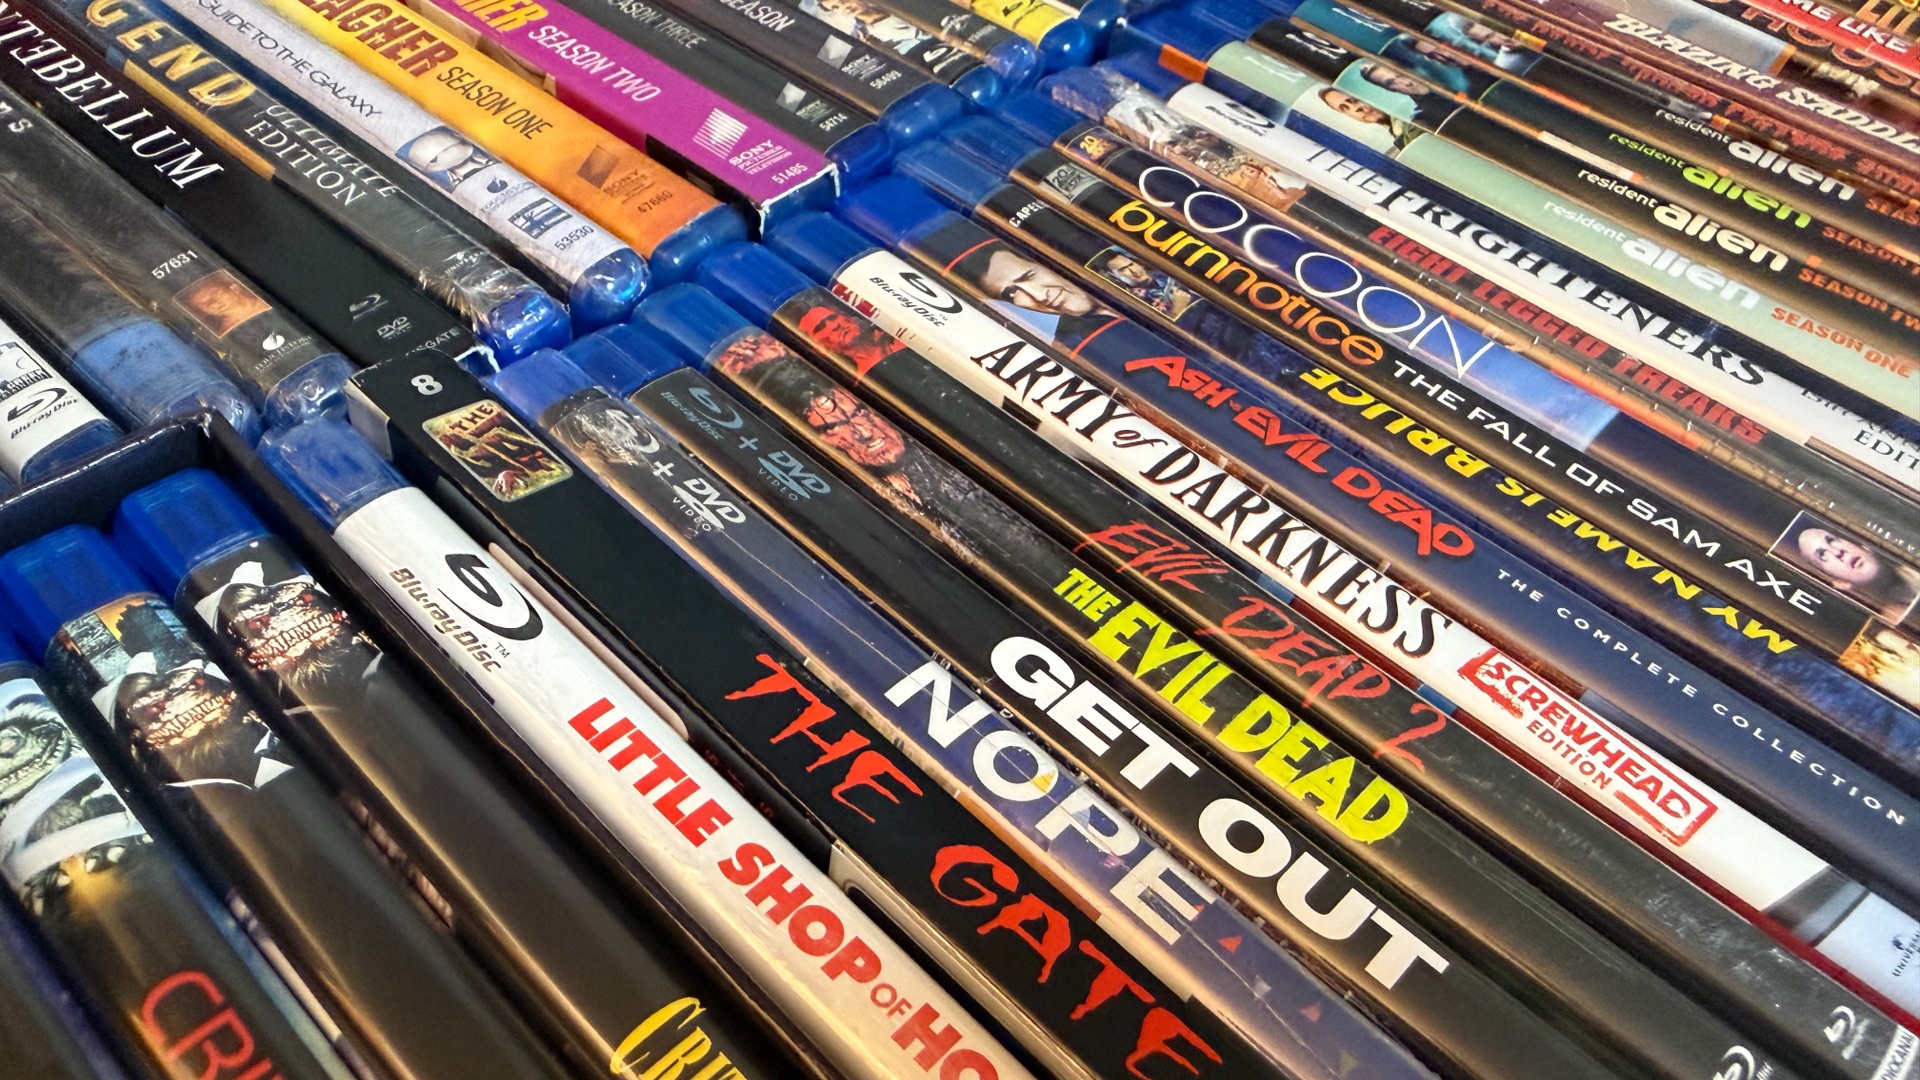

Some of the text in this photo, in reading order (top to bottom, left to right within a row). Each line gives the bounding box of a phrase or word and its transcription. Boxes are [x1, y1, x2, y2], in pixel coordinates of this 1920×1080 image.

[199, 0, 382, 117] GUIDE TO THE GALAXY
[528, 25, 616, 74] SEASON
[602, 67, 661, 102] TWO
[653, 18, 707, 48] THREE
[1604, 13, 1781, 90] BLAZING
[1838, 16, 1911, 53] LIKE
[436, 66, 516, 116] SEASON
[503, 107, 554, 141] ONE
[729, 139, 774, 166] SONY
[1655, 109, 1730, 144] resident
[1727, 139, 1856, 201] alien
[245, 119, 367, 206] EDITION
[1609, 133, 1683, 168] resident
[1682, 165, 1811, 229] alien
[1822, 225, 1908, 266] SEASON
[151, 249, 199, 280] 57631
[554, 225, 595, 252] 53530
[1138, 166, 1494, 380] COCOON
[1305, 147, 1764, 386] THE FRIGHTENERS
[1368, 225, 1468, 282] EIGHT
[1472, 280, 1609, 359] LEGGED
[1544, 200, 1910, 379] resident alien SEASON ONE
[1577, 168, 1658, 210] resident
[1653, 203, 1789, 272] alien
[1798, 267, 1888, 313] SEASON
[376, 315, 408, 336] DVD
[411, 374, 443, 396] 8
[449, 403, 496, 432] THE
[682, 477, 747, 524] DVD
[759, 467, 798, 501] VIDEO
[767, 451, 831, 494] DVD
[970, 340, 1454, 659] ARMY of DARKNESS
[1124, 354, 1476, 557] ASH EVIL DEAD
[1299, 366, 1798, 654] MY NAME IS BRUCE
[1393, 359, 1466, 412] THE
[1466, 406, 1558, 467] FALL
[1566, 462, 1625, 496] OF
[1626, 498, 1721, 557] SAM
[1724, 558, 1822, 616] AXE
[672, 497, 712, 532] VIDEO
[389, 567, 505, 673] Blu-ray Disc
[1073, 521, 1447, 774] EVIL DEAD 2
[1055, 568, 1410, 845] THE EVIL DEAD
[1482, 660, 1692, 821] SCREWHEAD
[1497, 568, 1906, 825] THE COMPLETE COLLECTION
[884, 660, 1219, 945] NOPE
[1526, 718, 1614, 791] EDITION
[567, 697, 734, 848] LITTLE
[717, 842, 882, 984] SHOP
[869, 981, 913, 1018] OF
[724, 653, 1223, 1078] THE GATE
[990, 636, 1451, 989] GET OUT
